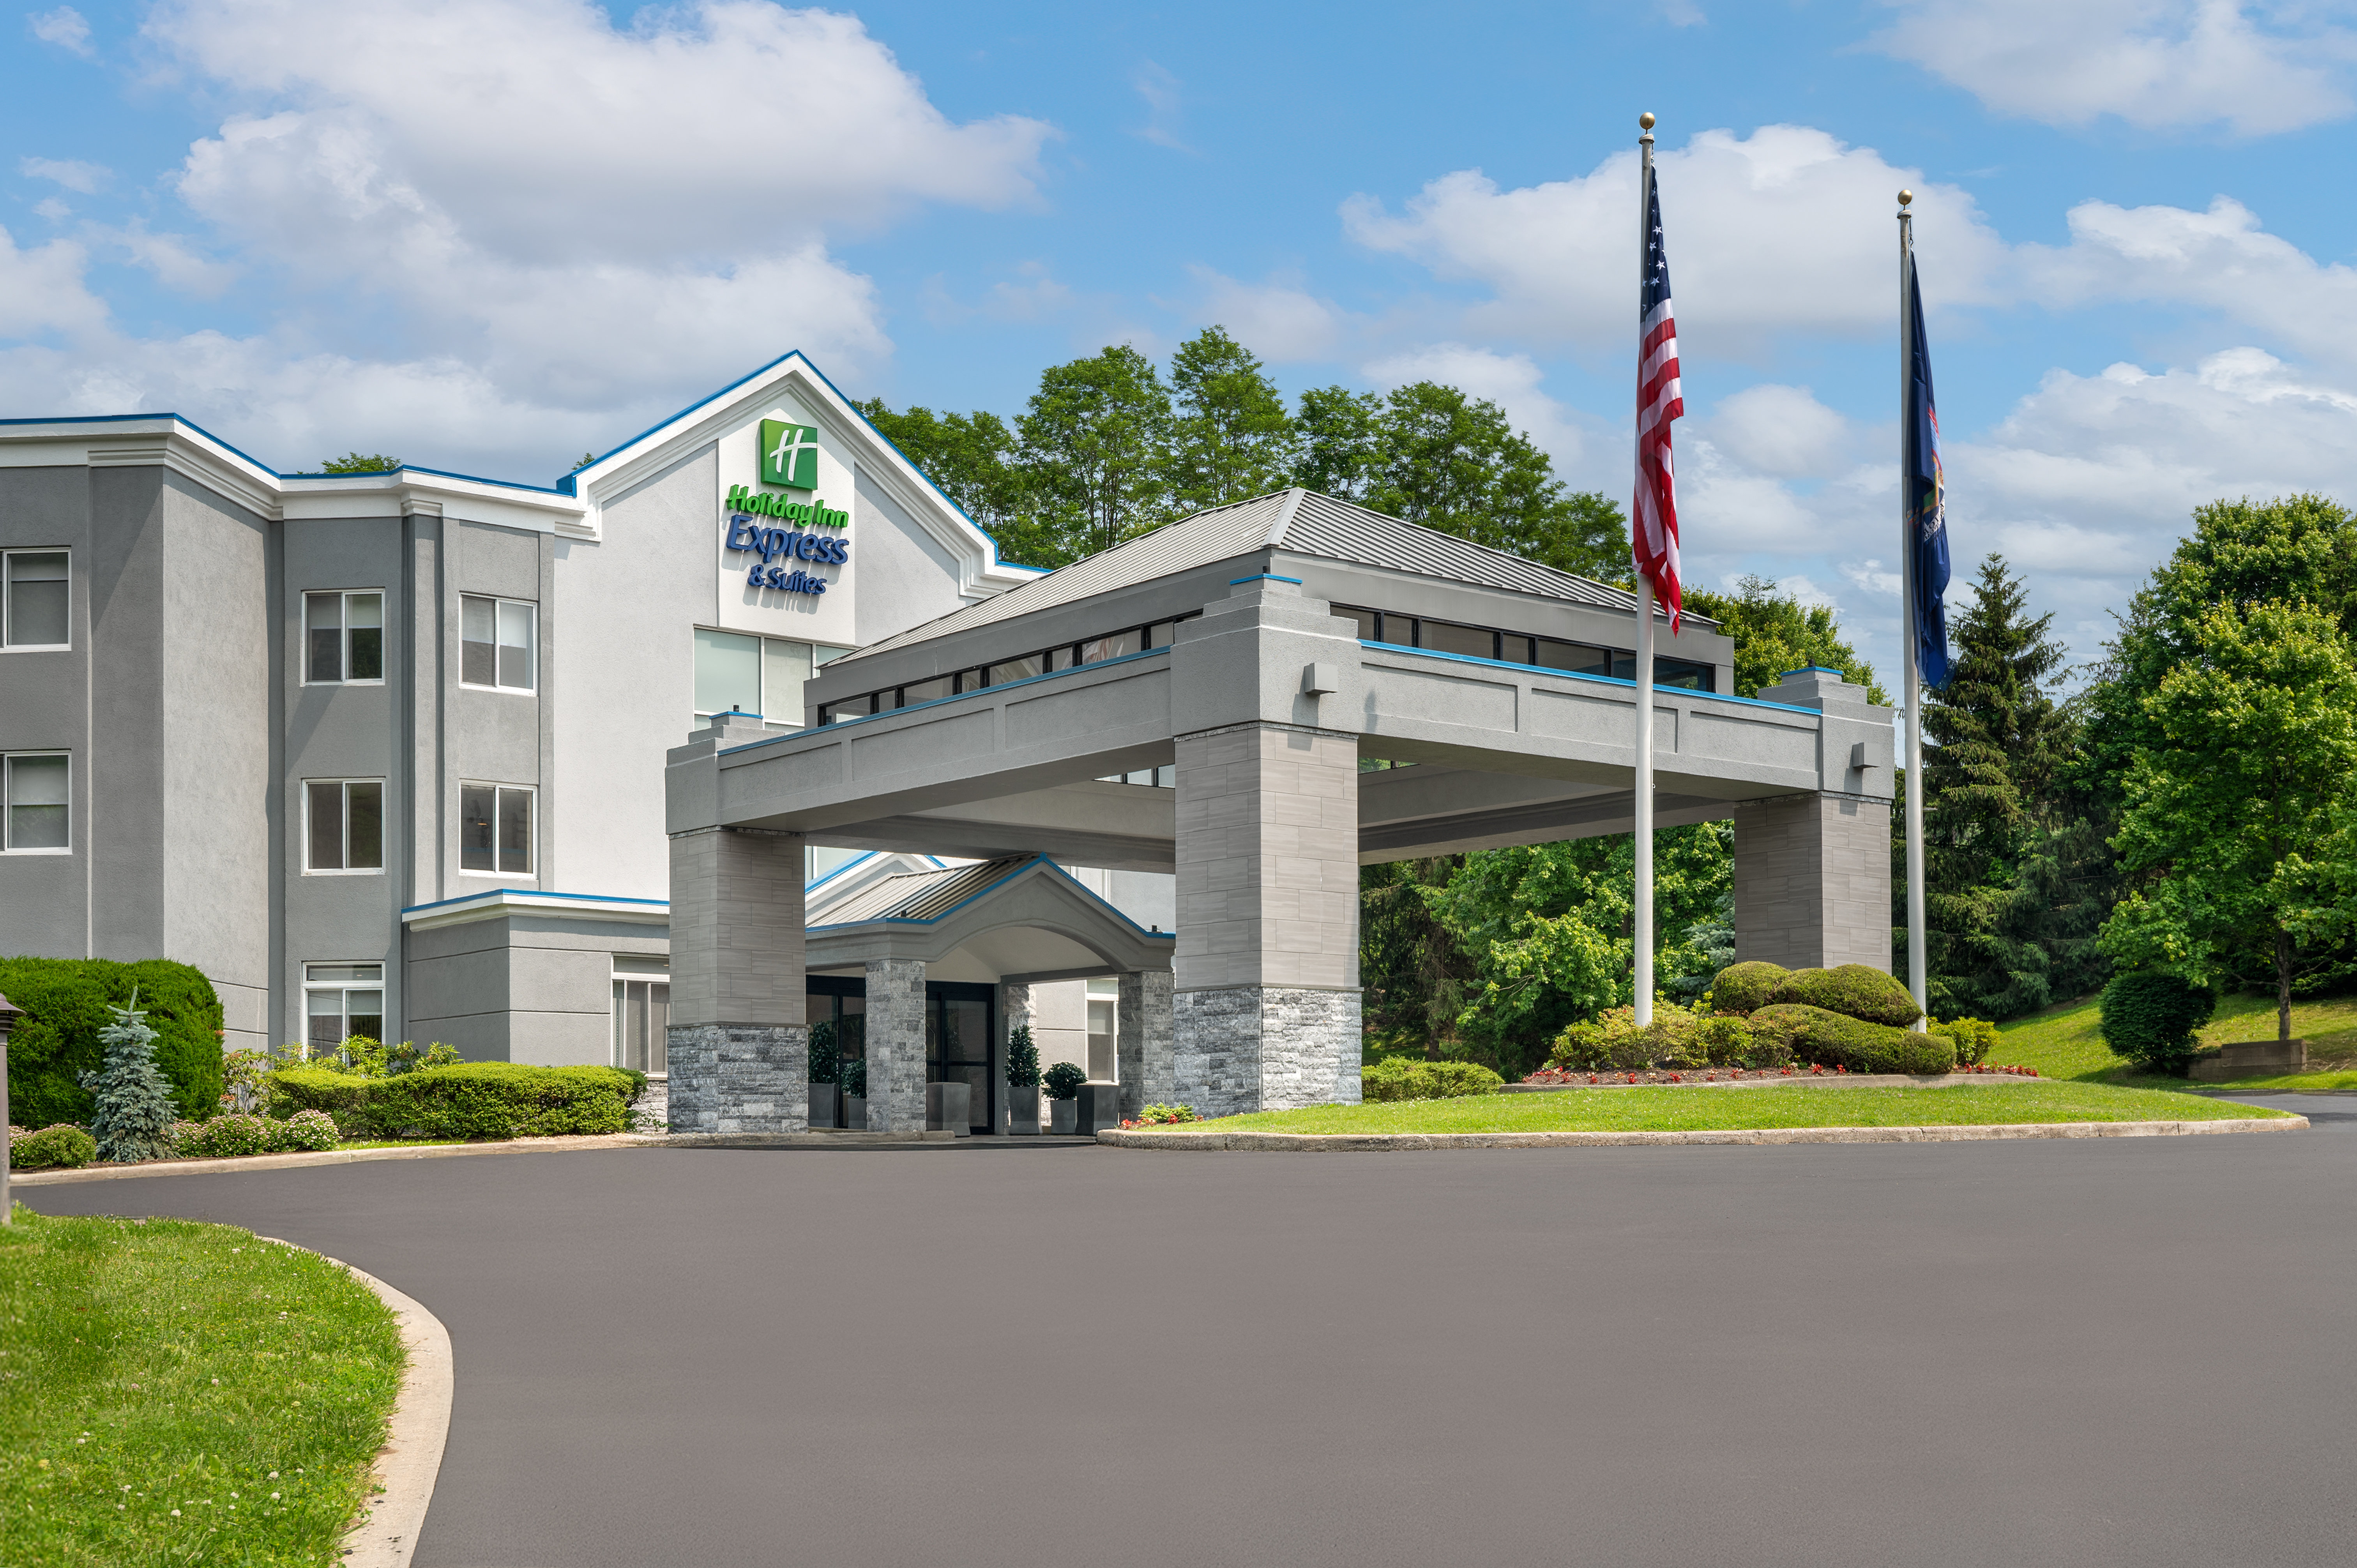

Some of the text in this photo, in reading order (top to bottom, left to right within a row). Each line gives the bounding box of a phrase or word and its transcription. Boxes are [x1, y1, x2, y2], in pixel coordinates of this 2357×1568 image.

[726, 484, 849, 528] Holiday Inn
[726, 514, 850, 565] Express
[748, 564, 827, 595] & Suites
